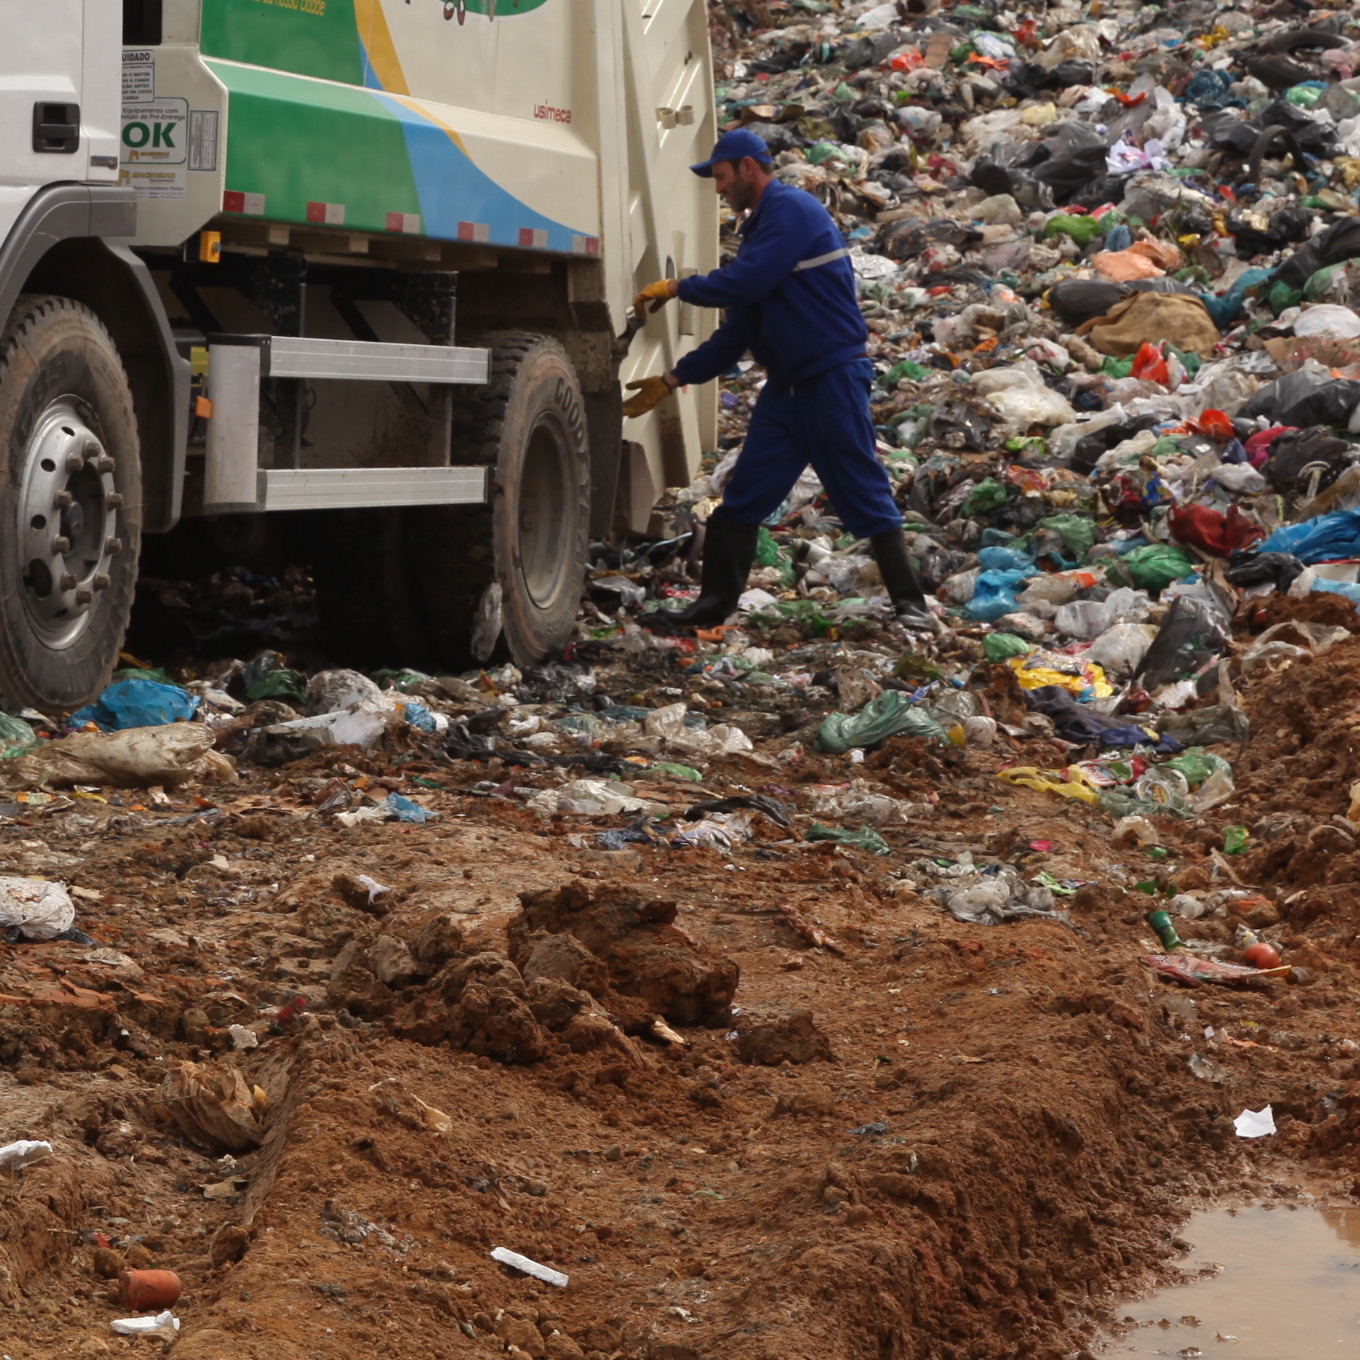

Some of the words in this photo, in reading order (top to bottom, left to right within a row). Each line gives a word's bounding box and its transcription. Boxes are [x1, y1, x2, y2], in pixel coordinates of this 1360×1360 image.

[121, 52, 151, 62] UIDADO
[533, 100, 572, 124] usimeca
[121, 121, 177, 148] OK
